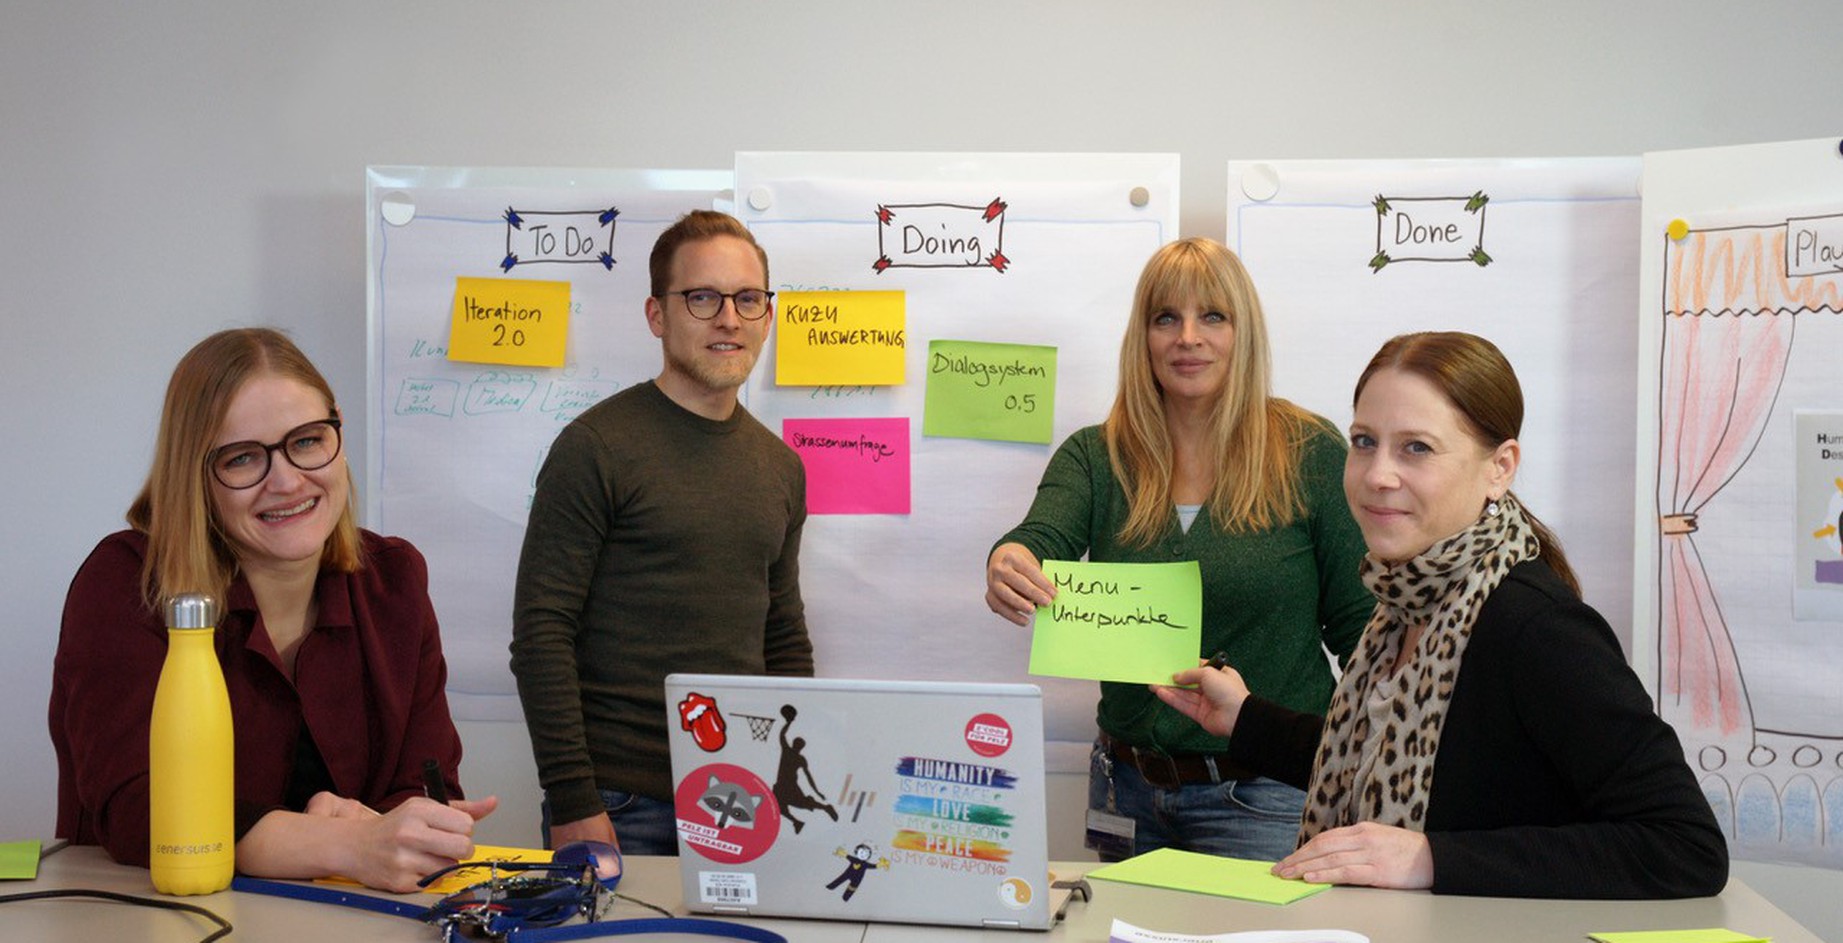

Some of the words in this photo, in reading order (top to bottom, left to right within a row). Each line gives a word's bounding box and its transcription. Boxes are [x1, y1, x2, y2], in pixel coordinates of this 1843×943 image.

[529, 224, 556, 256] To
[565, 226, 594, 257] Do
[1396, 212, 1462, 245] Done
[903, 223, 981, 266] Doing
[464, 296, 542, 322] Iteration
[492, 323, 525, 346] 2.0
[808, 327, 904, 349] AUSWERTUNG
[932, 352, 1046, 387] Dialogsystem
[1004, 394, 1036, 413] 0.5
[1054, 573, 1119, 594] Menu
[1052, 604, 1189, 629] Unterpunkte
[914, 758, 995, 786] HUMANITY
[900, 778, 911, 793] IS
[916, 780, 938, 795] MY
[933, 798, 971, 821] LOVE
[681, 822, 701, 833] PELZ
[702, 826, 717, 836] IST
[941, 820, 1000, 840] RELIGION
[926, 832, 973, 858] PEACE
[890, 850, 901, 863] IS
[905, 851, 925, 866] MY
[940, 858, 996, 876] WEAPON
